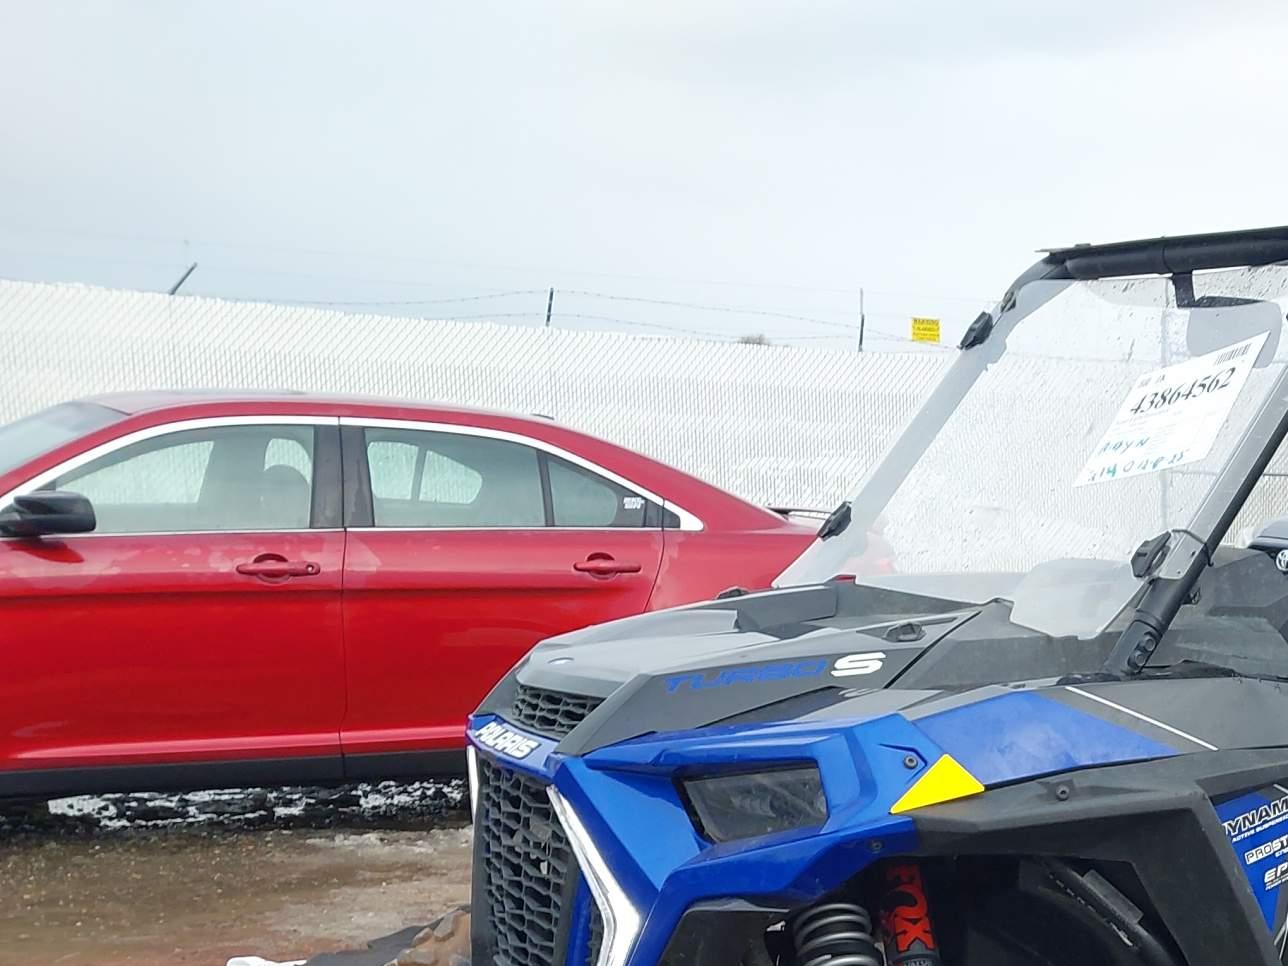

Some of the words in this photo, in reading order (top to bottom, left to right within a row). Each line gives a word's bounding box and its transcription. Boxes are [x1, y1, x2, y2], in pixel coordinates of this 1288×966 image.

[1129, 366, 1237, 415] 43864562
[665, 658, 827, 694] TURBO
[830, 651, 887, 678] S
[474, 721, 540, 758] POLARIS
